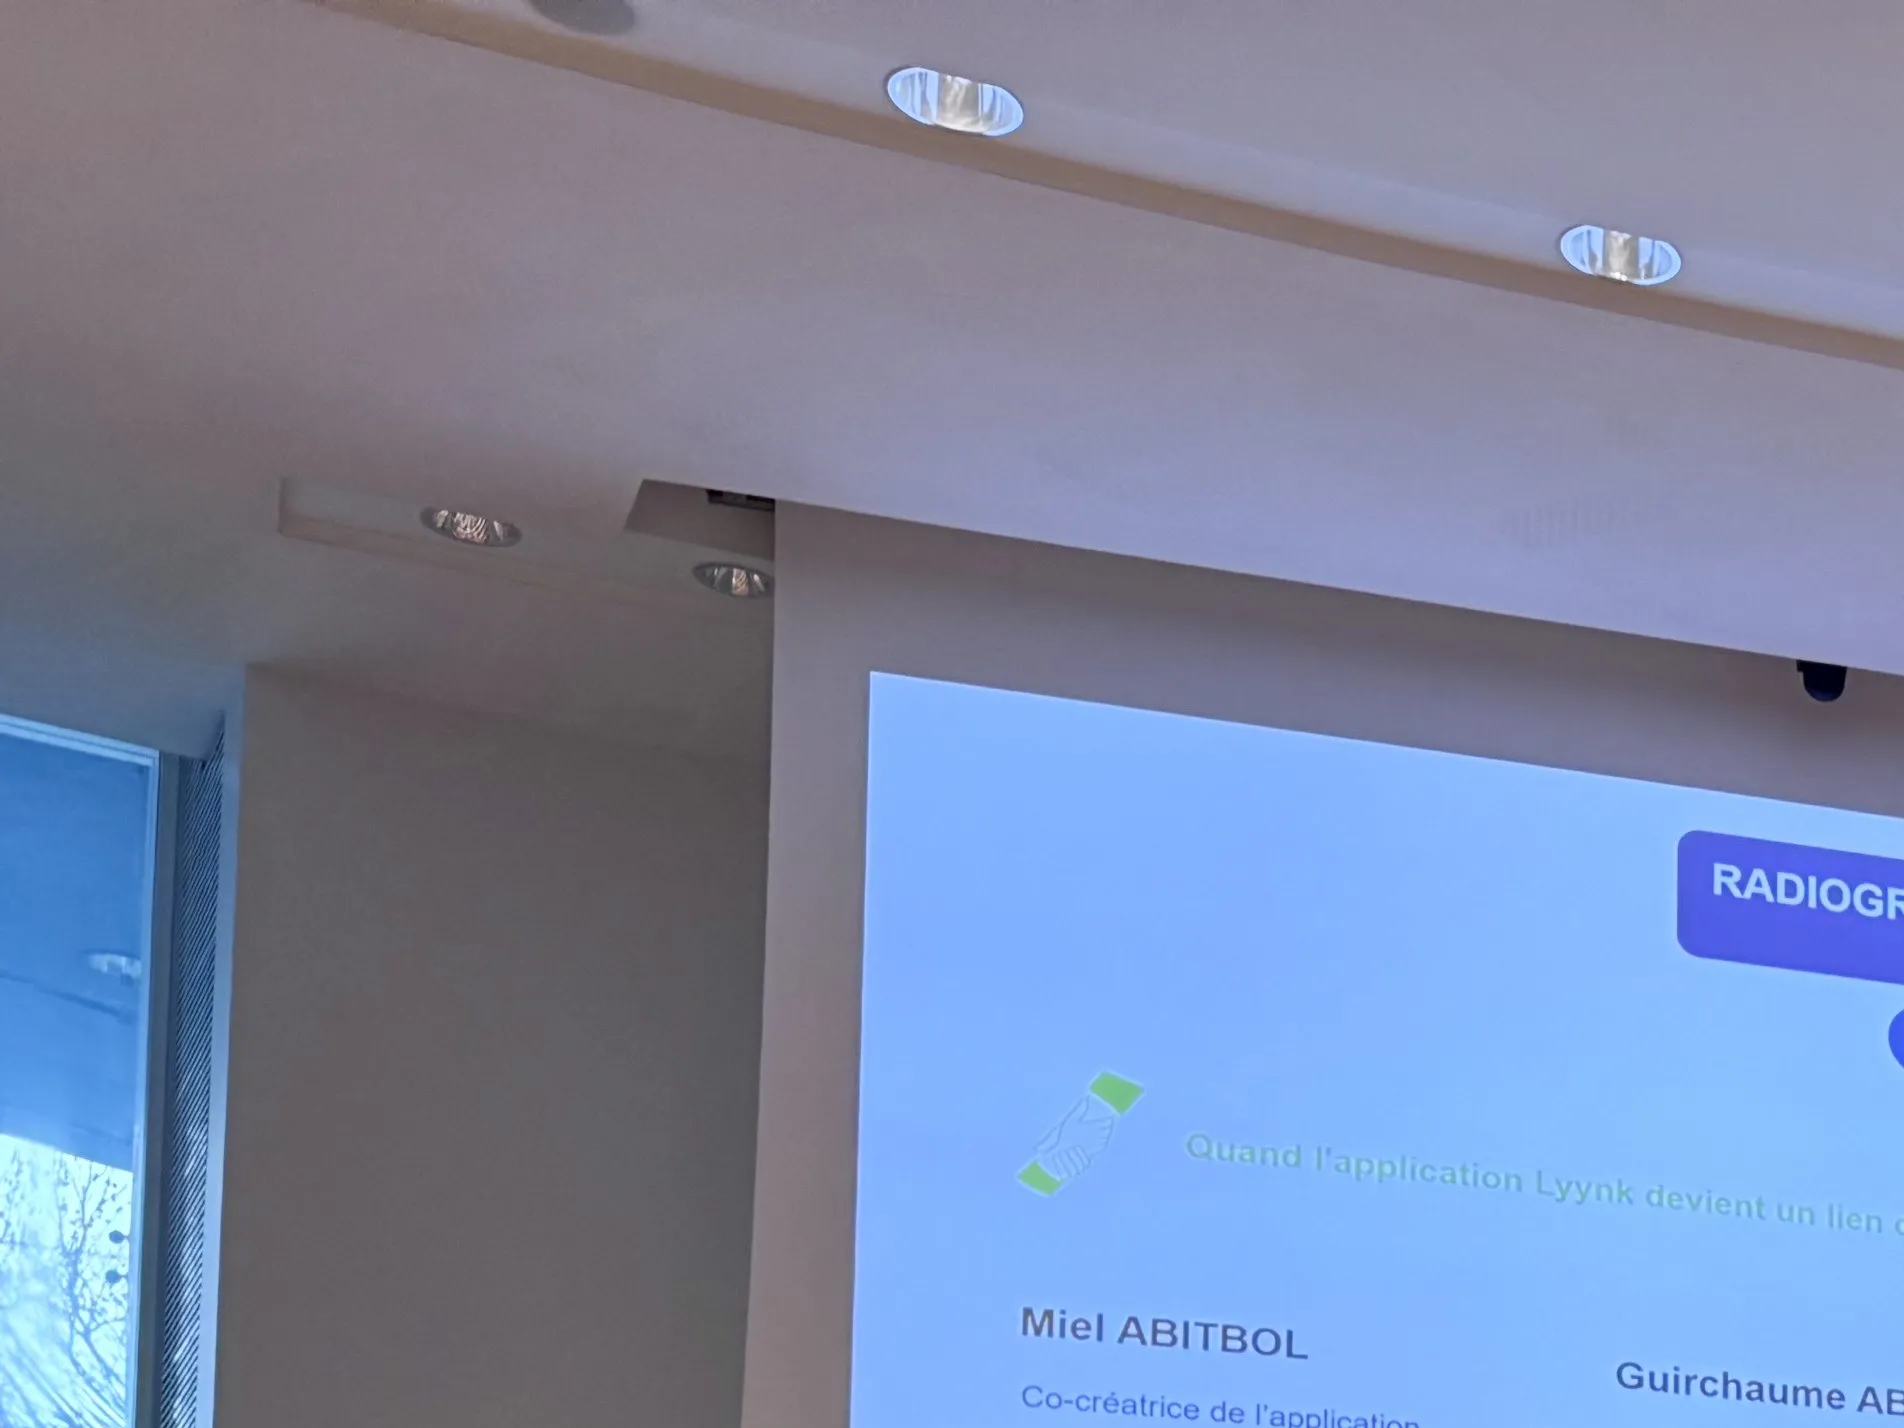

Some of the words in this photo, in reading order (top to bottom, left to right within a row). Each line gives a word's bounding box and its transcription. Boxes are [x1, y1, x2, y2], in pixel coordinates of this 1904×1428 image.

[1186, 1132, 1302, 1169] Quand
[1316, 1144, 1523, 1194] l'application
[1536, 1170, 1634, 1206] Lyynk
[1646, 1184, 1766, 1222] devient
[1776, 1202, 1815, 1226] un
[1828, 1204, 1883, 1235] lien
[1021, 1306, 1104, 1342] Miel
[1117, 1315, 1309, 1360] ABITBOL
[1022, 1385, 1200, 1421] Co-créatrice
[1210, 1400, 1245, 1424] de
[1616, 1362, 1846, 1410] Guirchaume
